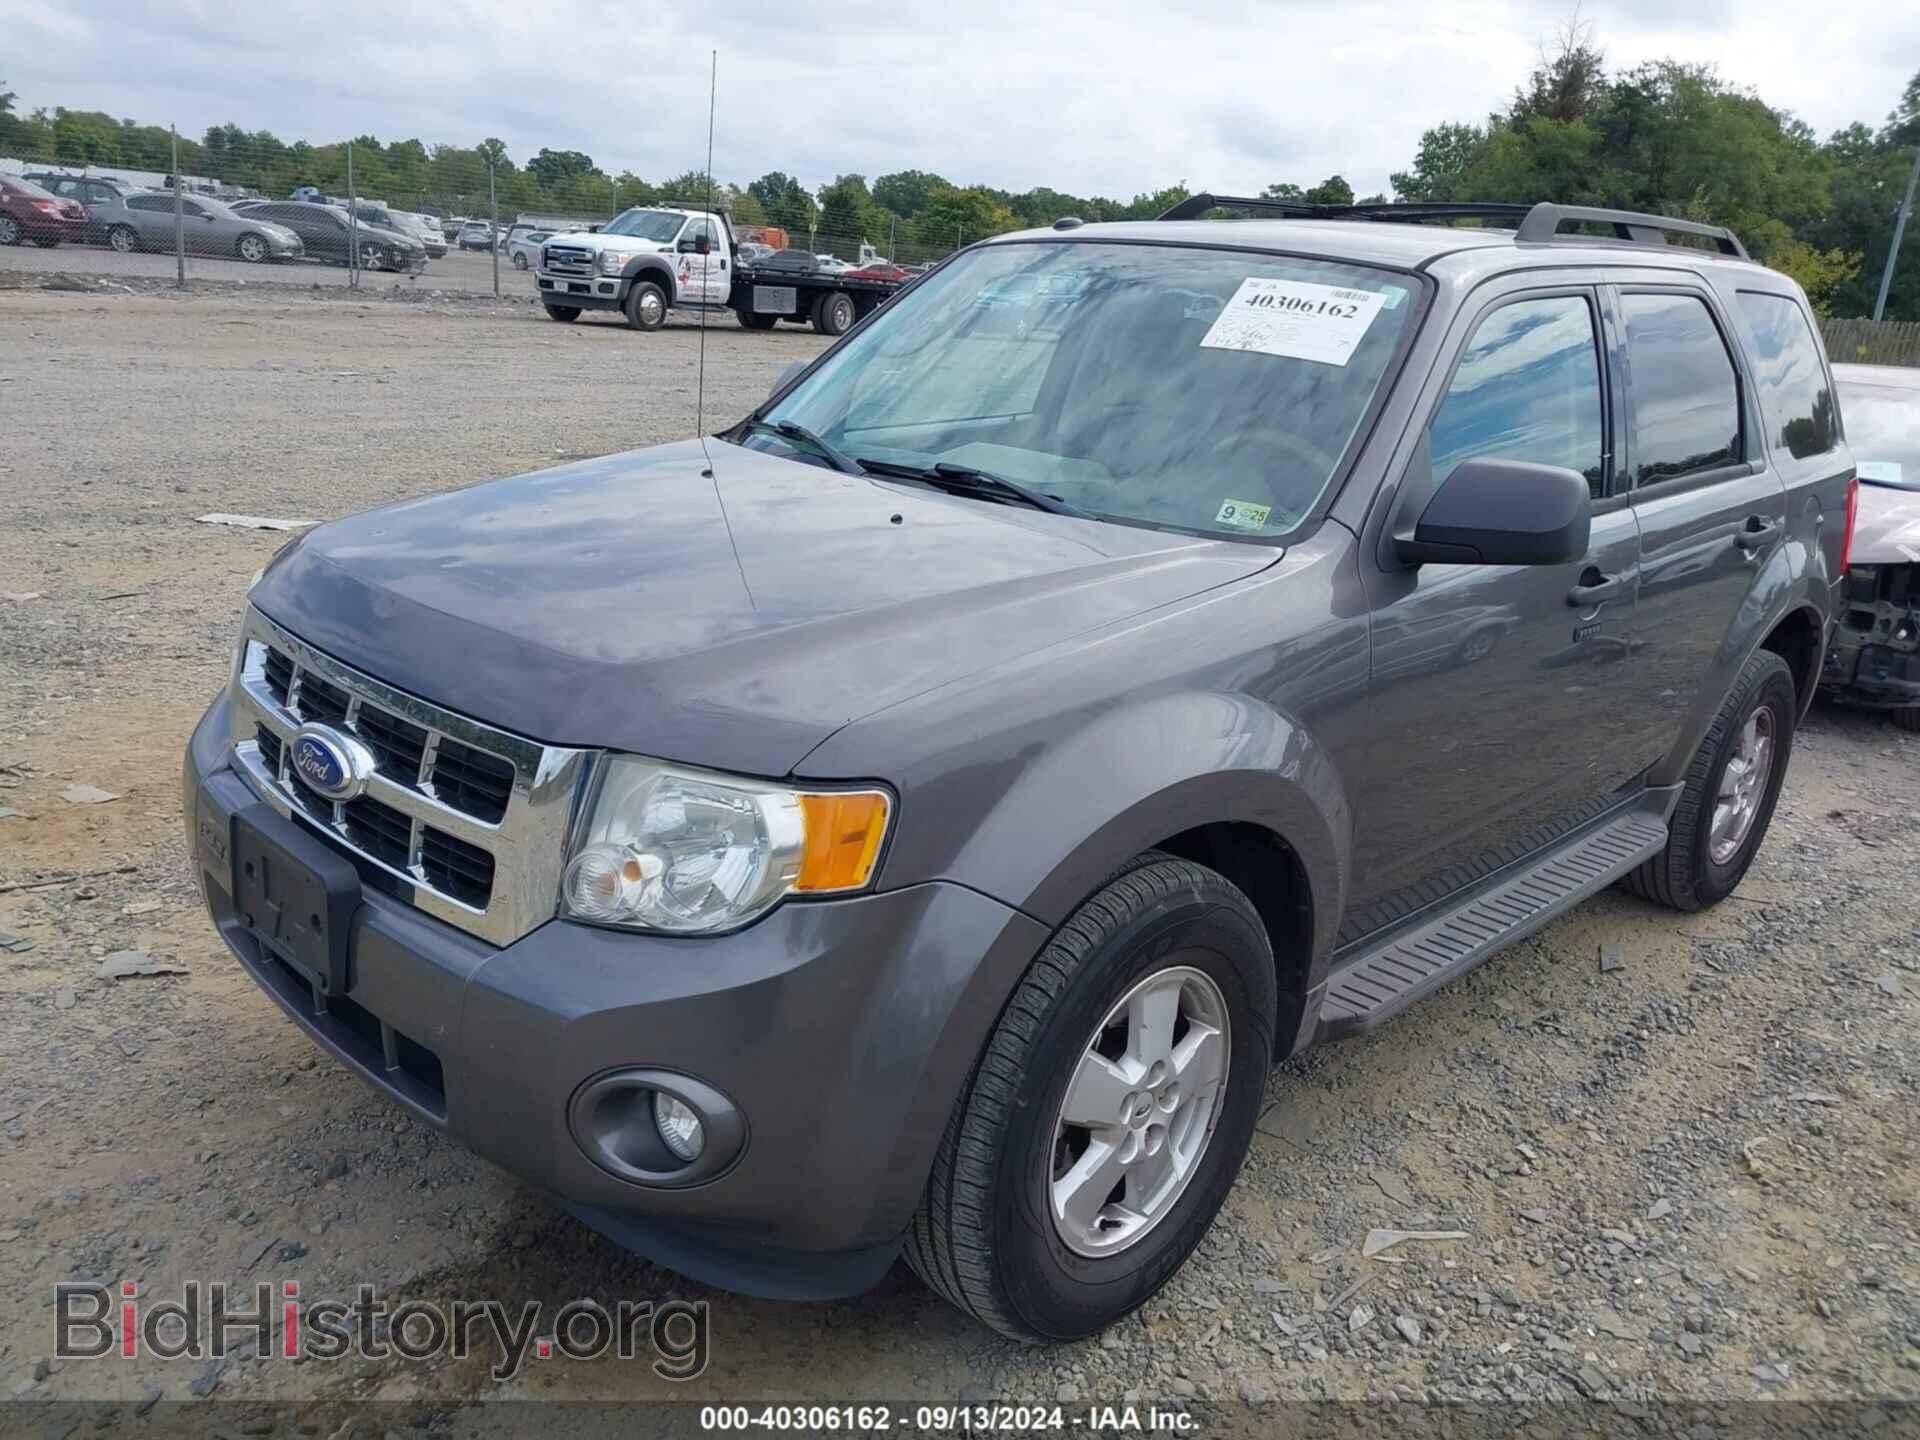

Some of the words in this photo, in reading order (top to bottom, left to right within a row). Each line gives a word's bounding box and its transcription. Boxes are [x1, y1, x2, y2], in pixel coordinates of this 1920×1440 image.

[1245, 293, 1359, 319] 40306162
[1222, 505, 1236, 519] 9
[299, 742, 330, 781] Ford
